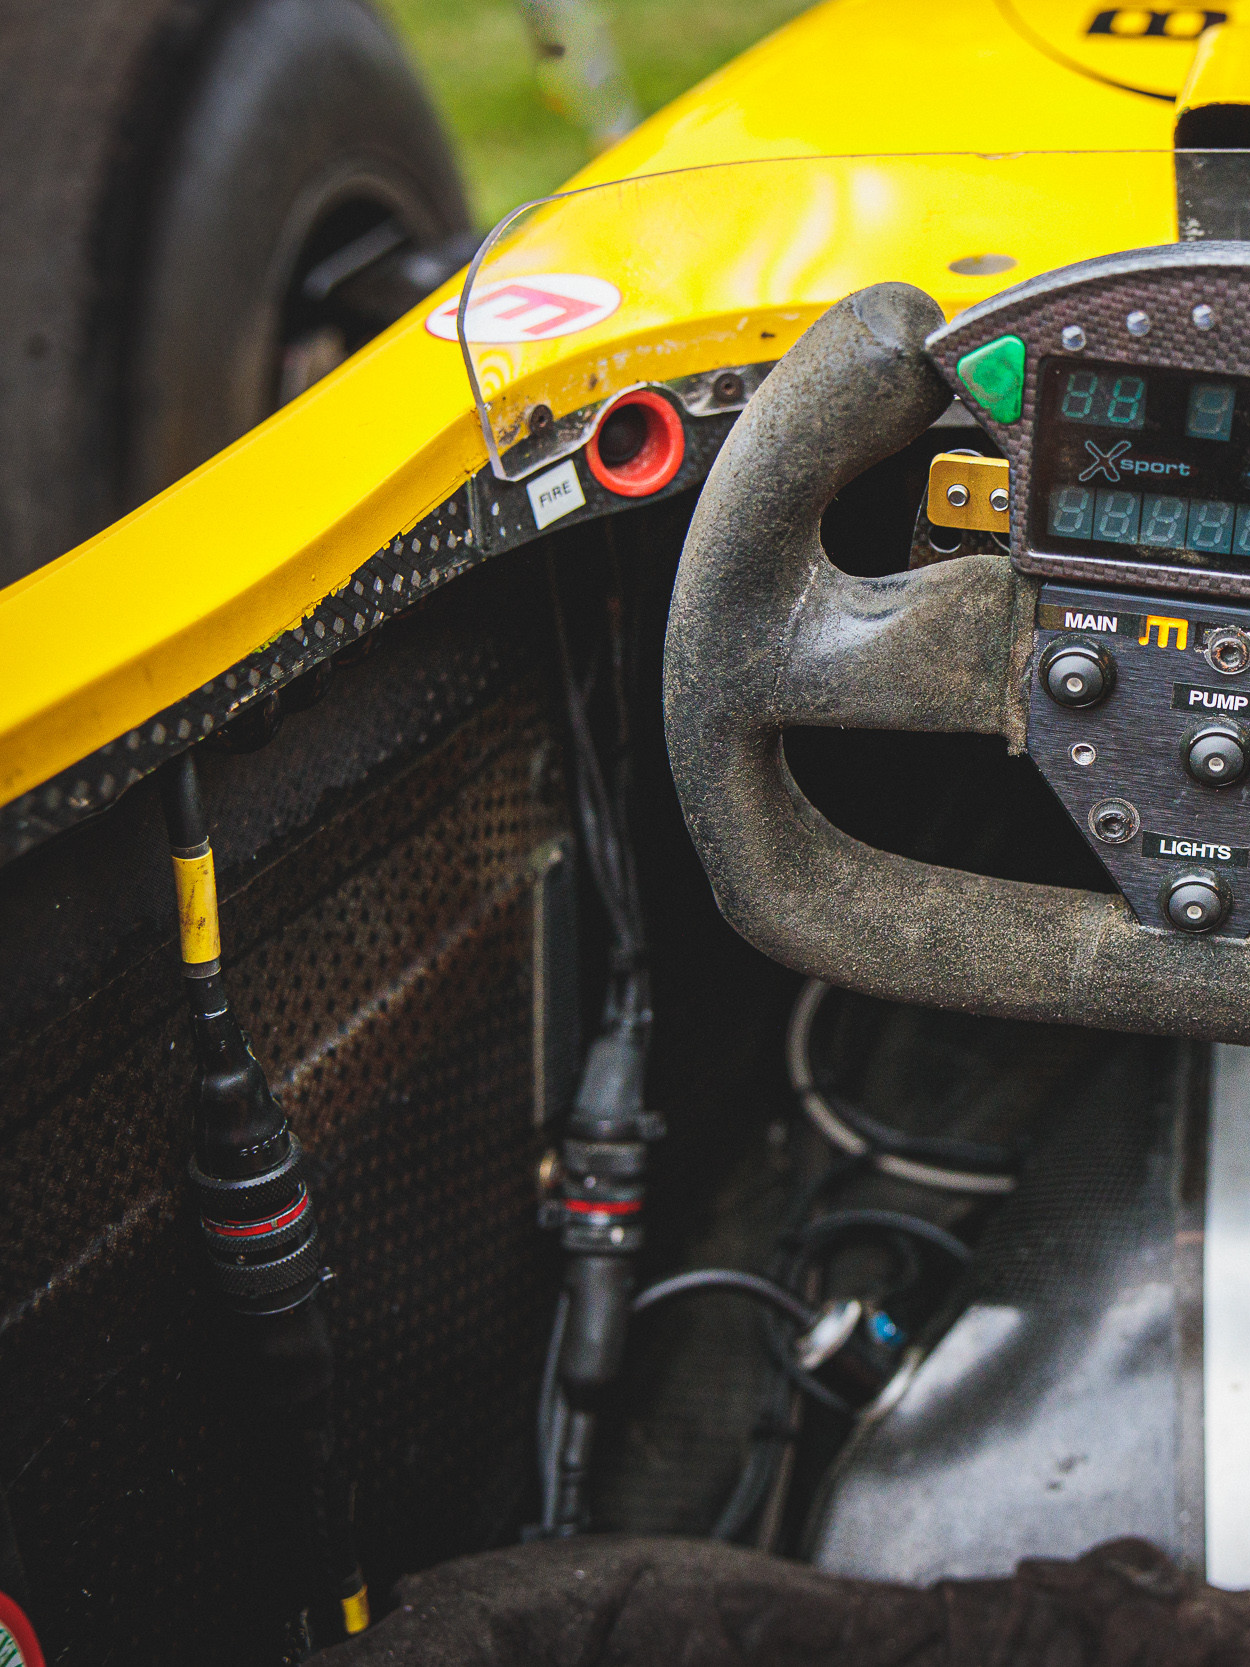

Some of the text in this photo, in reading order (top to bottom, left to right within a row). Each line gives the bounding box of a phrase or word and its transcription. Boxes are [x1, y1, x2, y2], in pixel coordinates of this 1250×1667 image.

[442, 284, 603, 336] E
[539, 480, 573, 508] FIRE
[1065, 612, 1118, 633] MAIN
[1188, 690, 1249, 710] PUMP
[1160, 839, 1232, 861] LIGHTS
